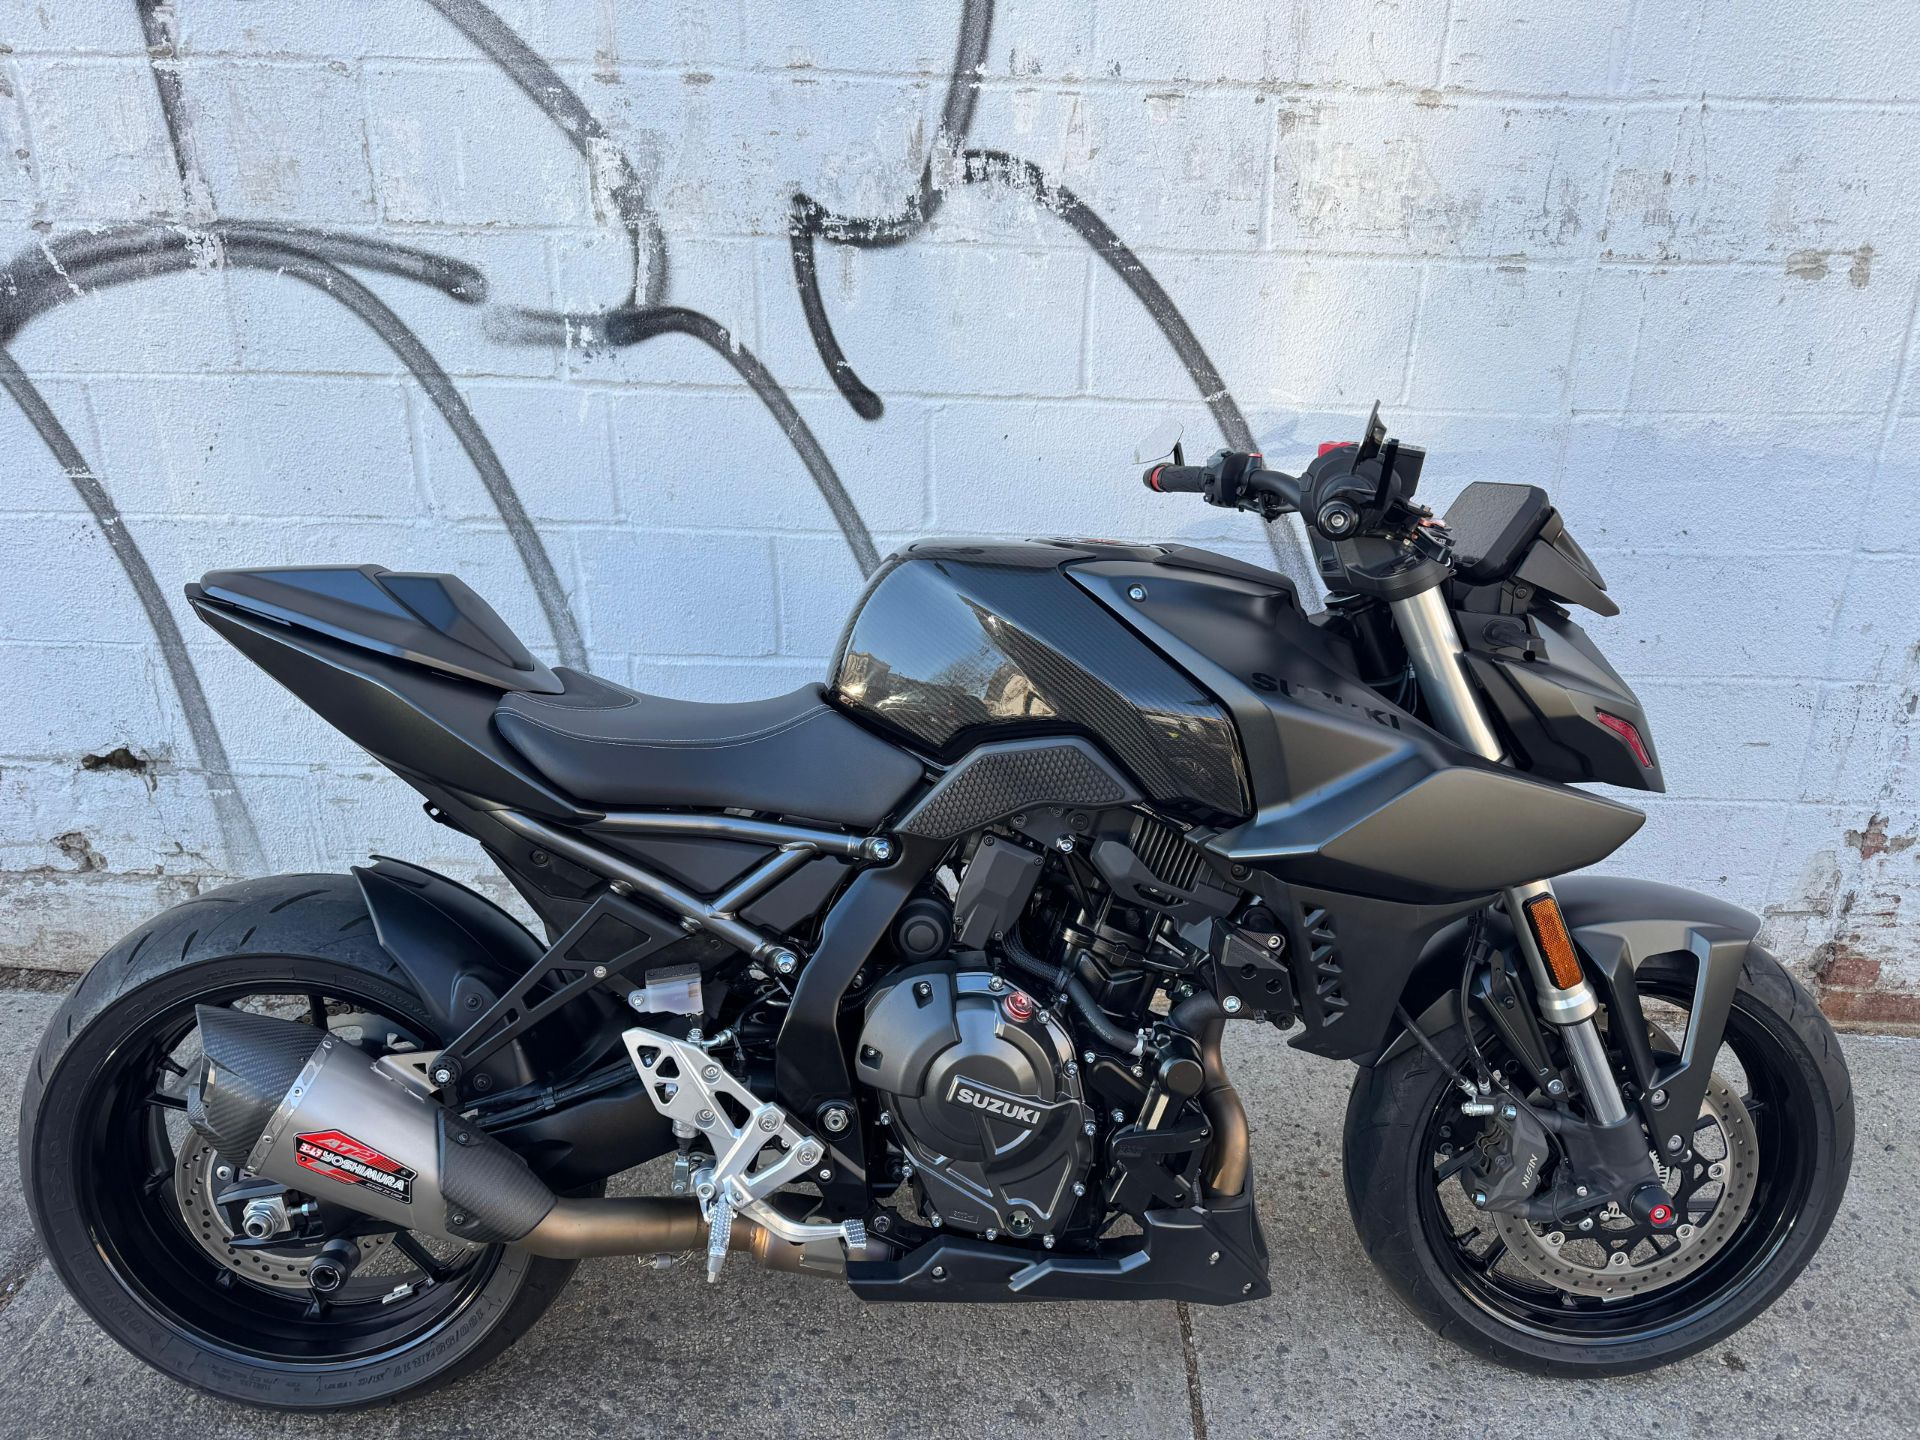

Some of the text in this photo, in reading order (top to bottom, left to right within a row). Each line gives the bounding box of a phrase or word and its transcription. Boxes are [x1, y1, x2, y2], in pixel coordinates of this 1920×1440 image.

[957, 1088, 1041, 1124] SUZUKI
[321, 1150, 405, 1192] YOSHIMURA
[1521, 1153, 1538, 1189] NISSIN
